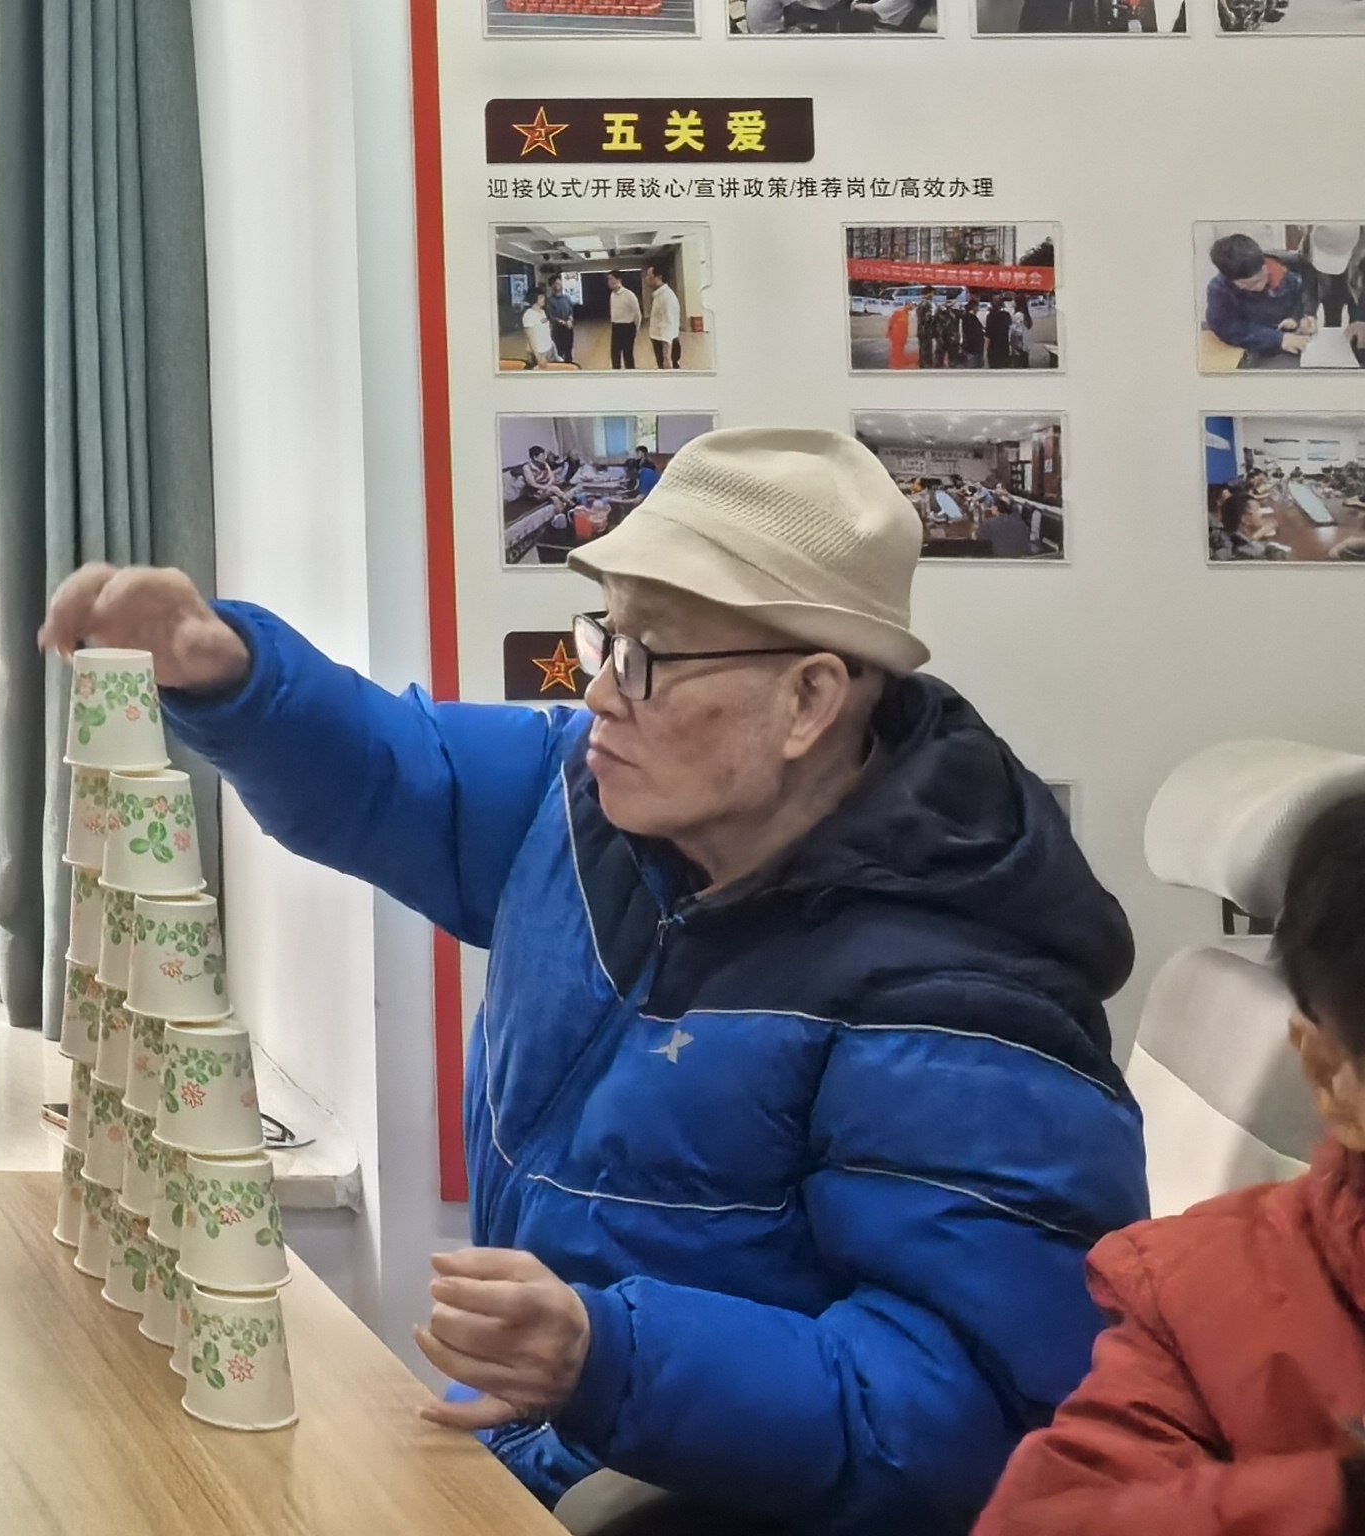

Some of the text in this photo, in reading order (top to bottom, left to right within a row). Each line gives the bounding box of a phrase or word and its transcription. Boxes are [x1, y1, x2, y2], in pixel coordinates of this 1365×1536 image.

[602, 110, 767, 152] 五关爱
[487, 177, 994, 200] 迎接仪式/开展谈心/宣讲政策/推荐岗位/高效办理
